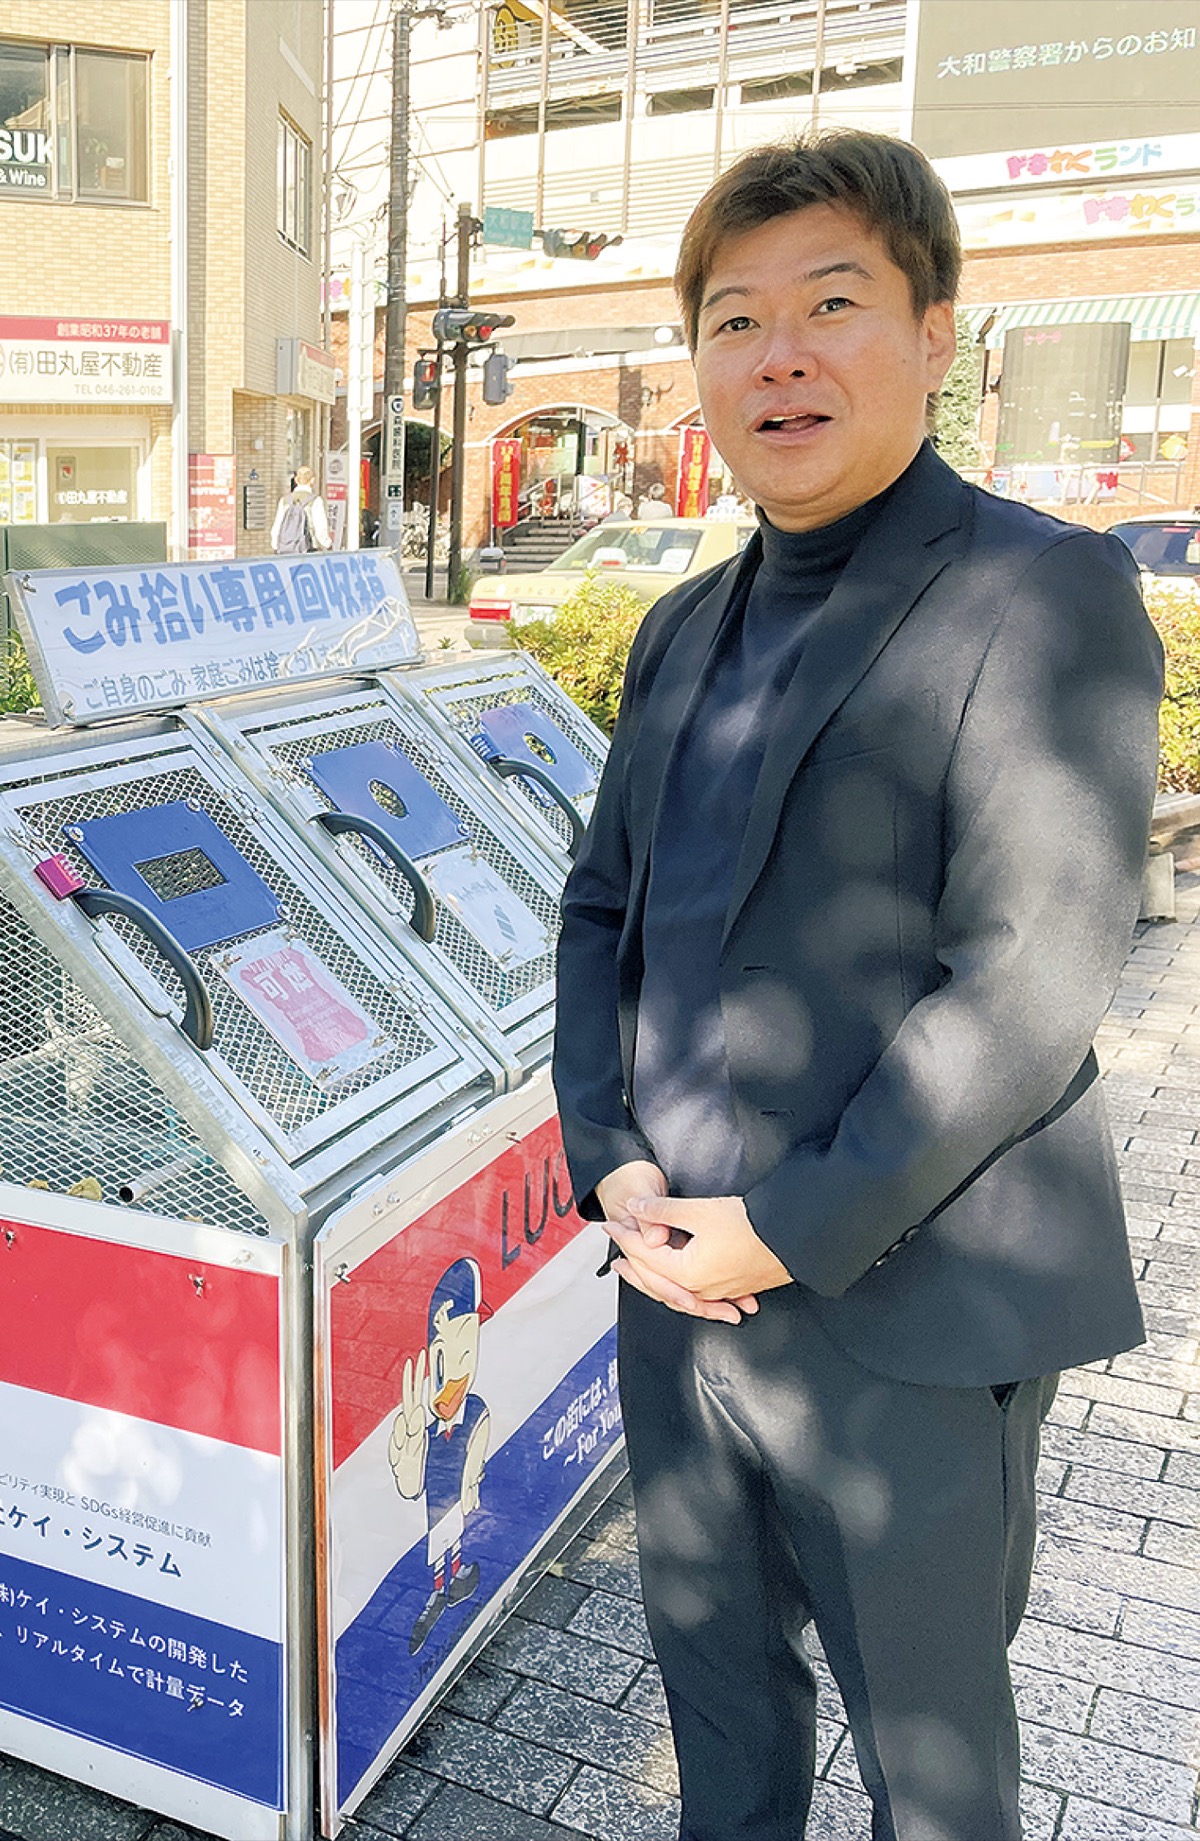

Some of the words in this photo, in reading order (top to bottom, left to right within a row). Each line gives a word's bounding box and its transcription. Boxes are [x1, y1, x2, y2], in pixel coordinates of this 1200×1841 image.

[936, 27, 1197, 79] 大和警察署からのお知
[9, 168, 46, 187] Wine
[57, 322, 162, 340] 創業昭和37年の老舗
[9, 349, 163, 378] (有)田丸屋不動産
[74, 383, 93, 395] TEL
[95, 384, 164, 396] 046-261-0162
[54, 555, 388, 655] ごみ拾い専用回収箱
[80, 1496, 213, 1548] SDGs経営促進に貢献
